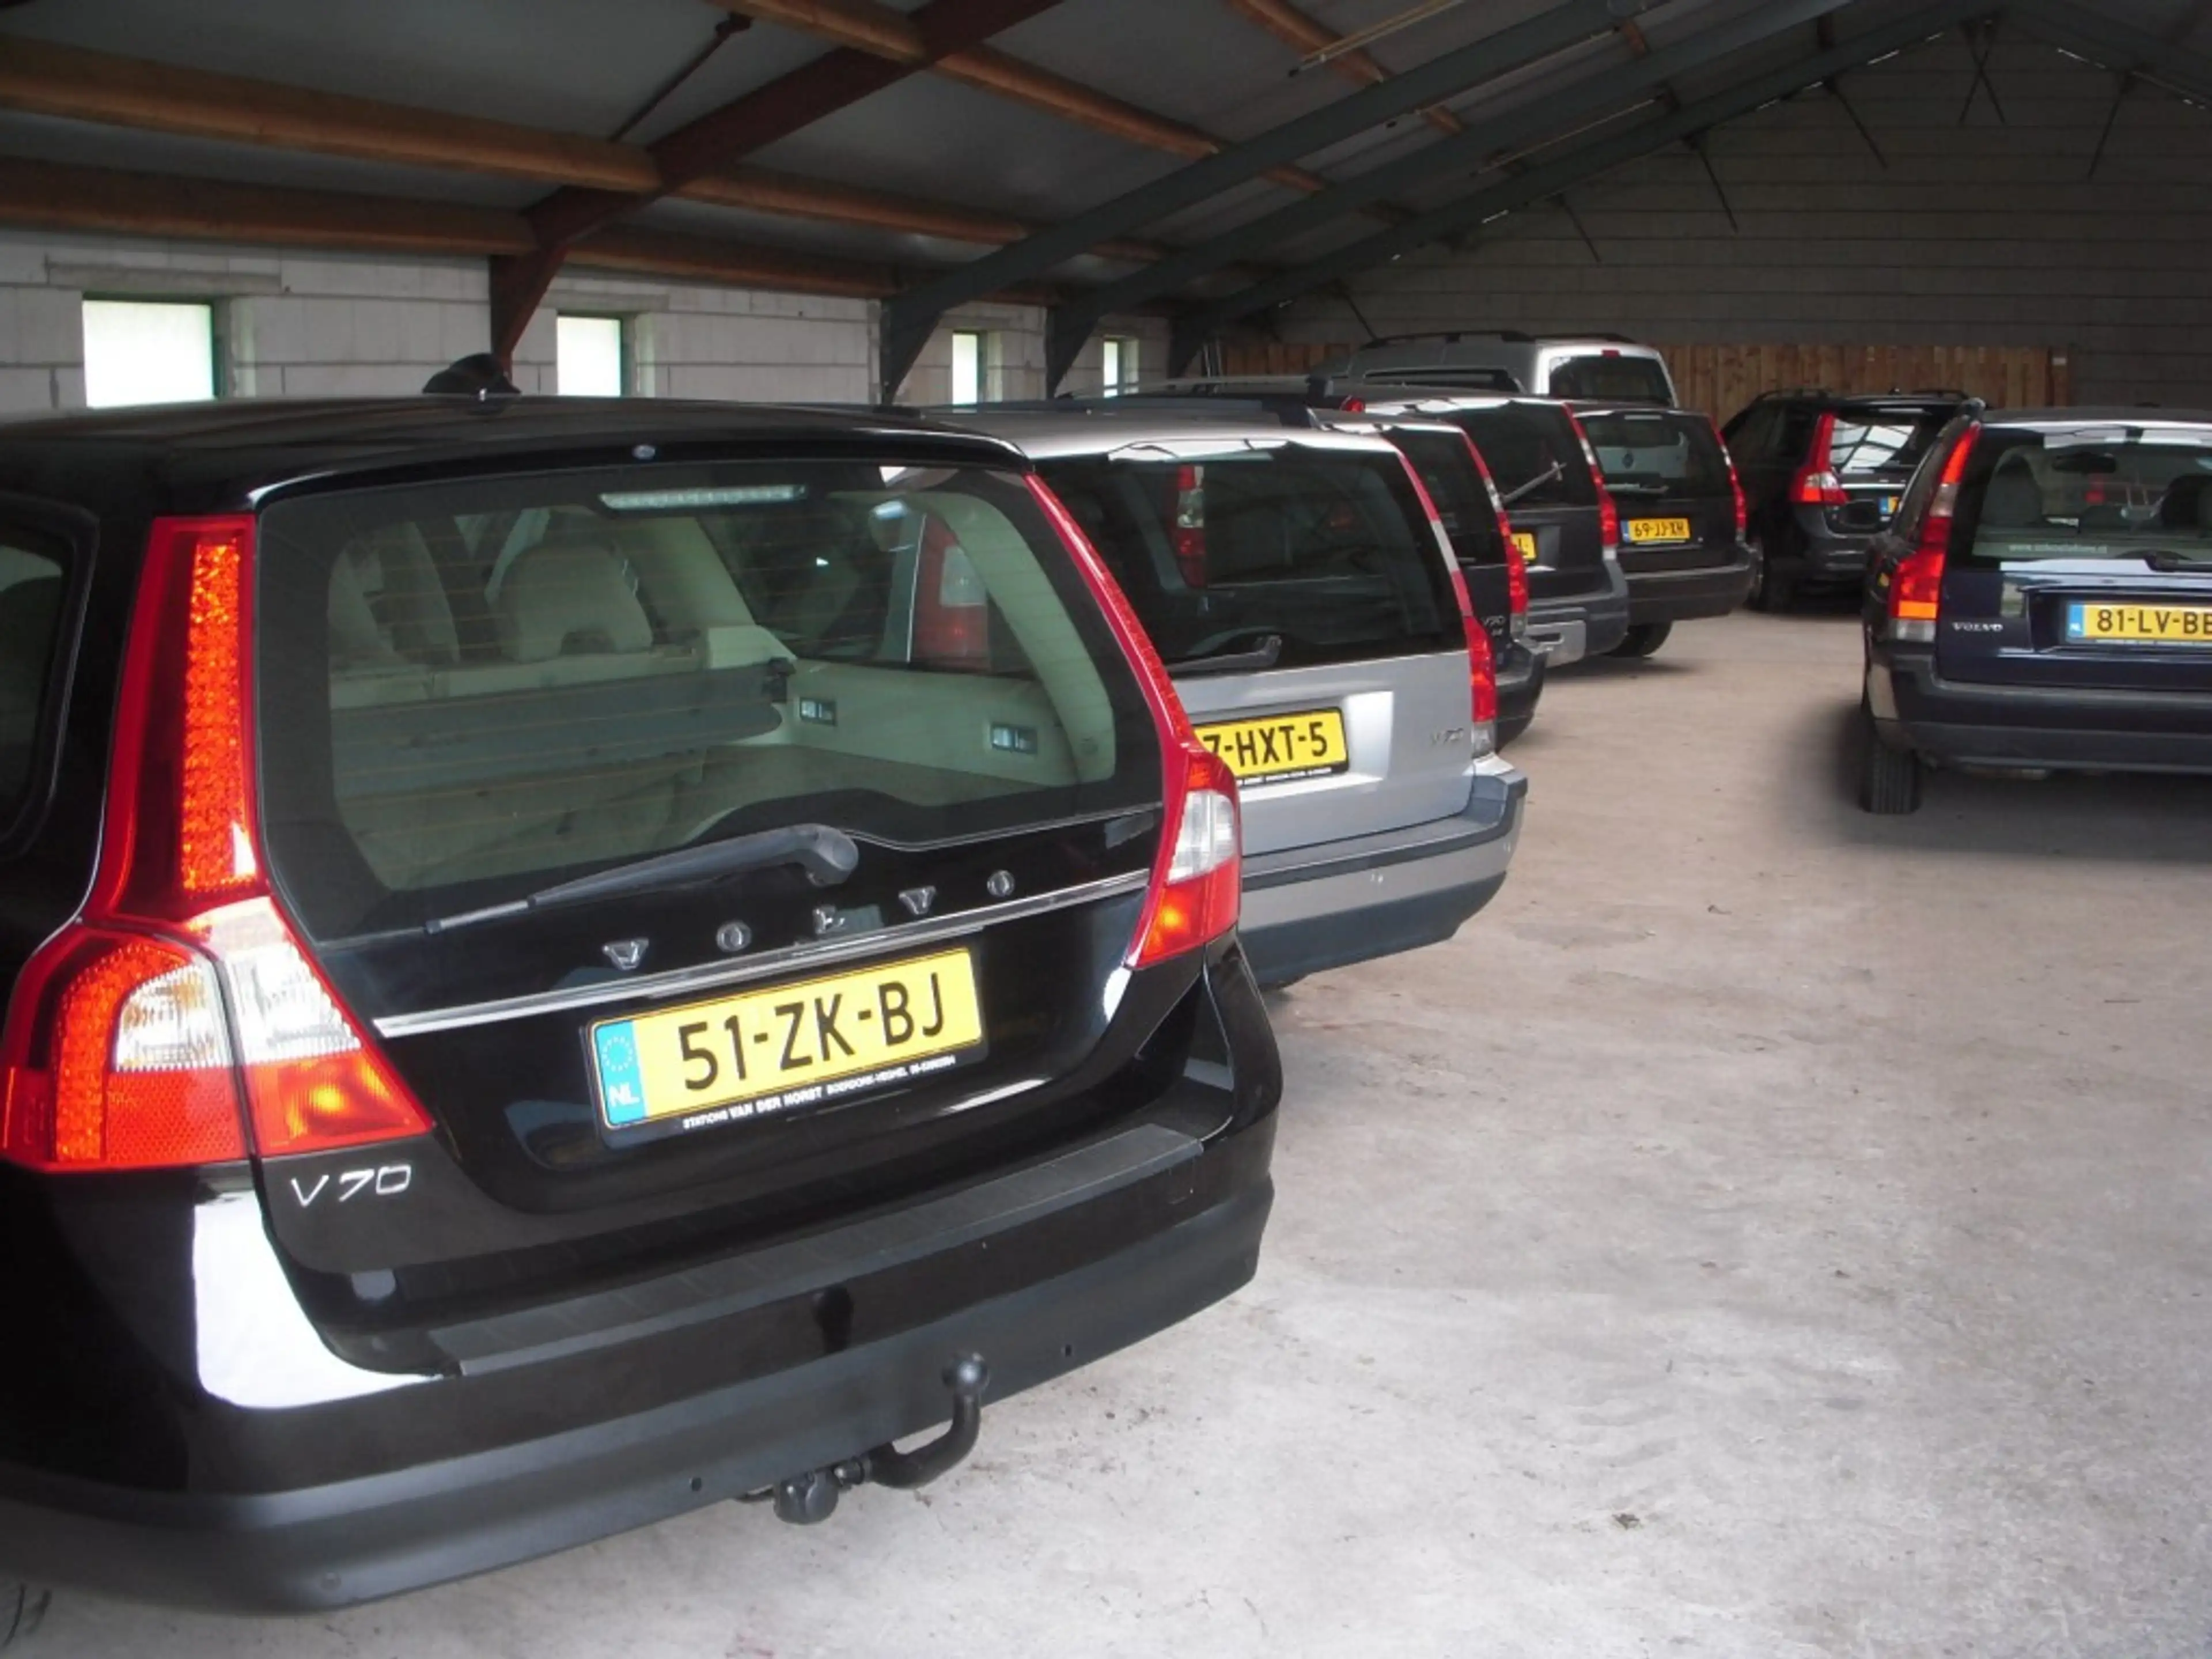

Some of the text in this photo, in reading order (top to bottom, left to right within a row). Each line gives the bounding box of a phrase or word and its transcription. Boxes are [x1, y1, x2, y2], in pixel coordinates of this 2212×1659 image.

[1952, 622, 2003, 632] VOLVO
[679, 972, 945, 1091] 51-ZK-BJ
[608, 1085, 640, 1107] NL
[728, 1102, 754, 1119] VAN
[291, 1164, 411, 1207] V70
